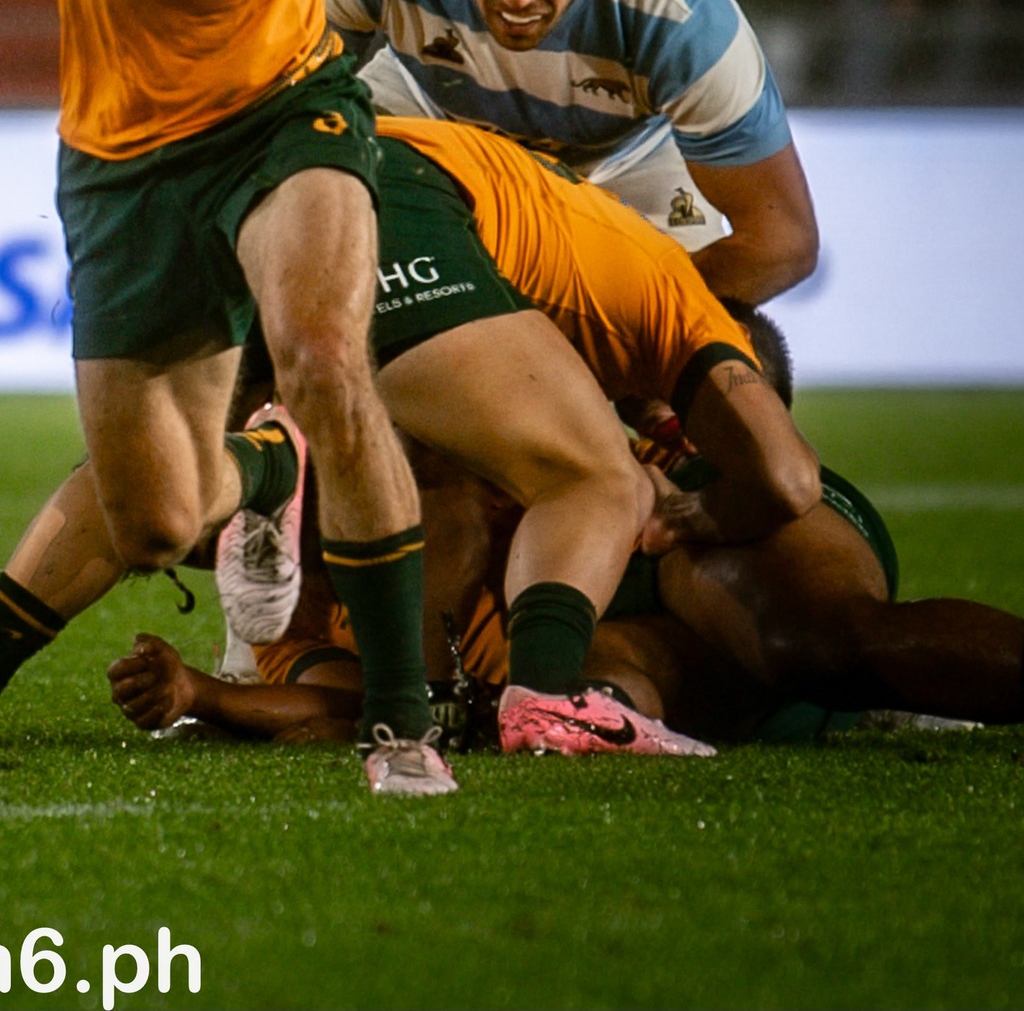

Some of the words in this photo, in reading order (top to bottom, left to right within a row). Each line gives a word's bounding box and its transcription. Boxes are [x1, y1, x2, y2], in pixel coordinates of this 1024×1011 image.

[377, 256, 440, 293] HG
[376, 298, 403, 314] ELS
[414, 282, 476, 303] RESORTS
